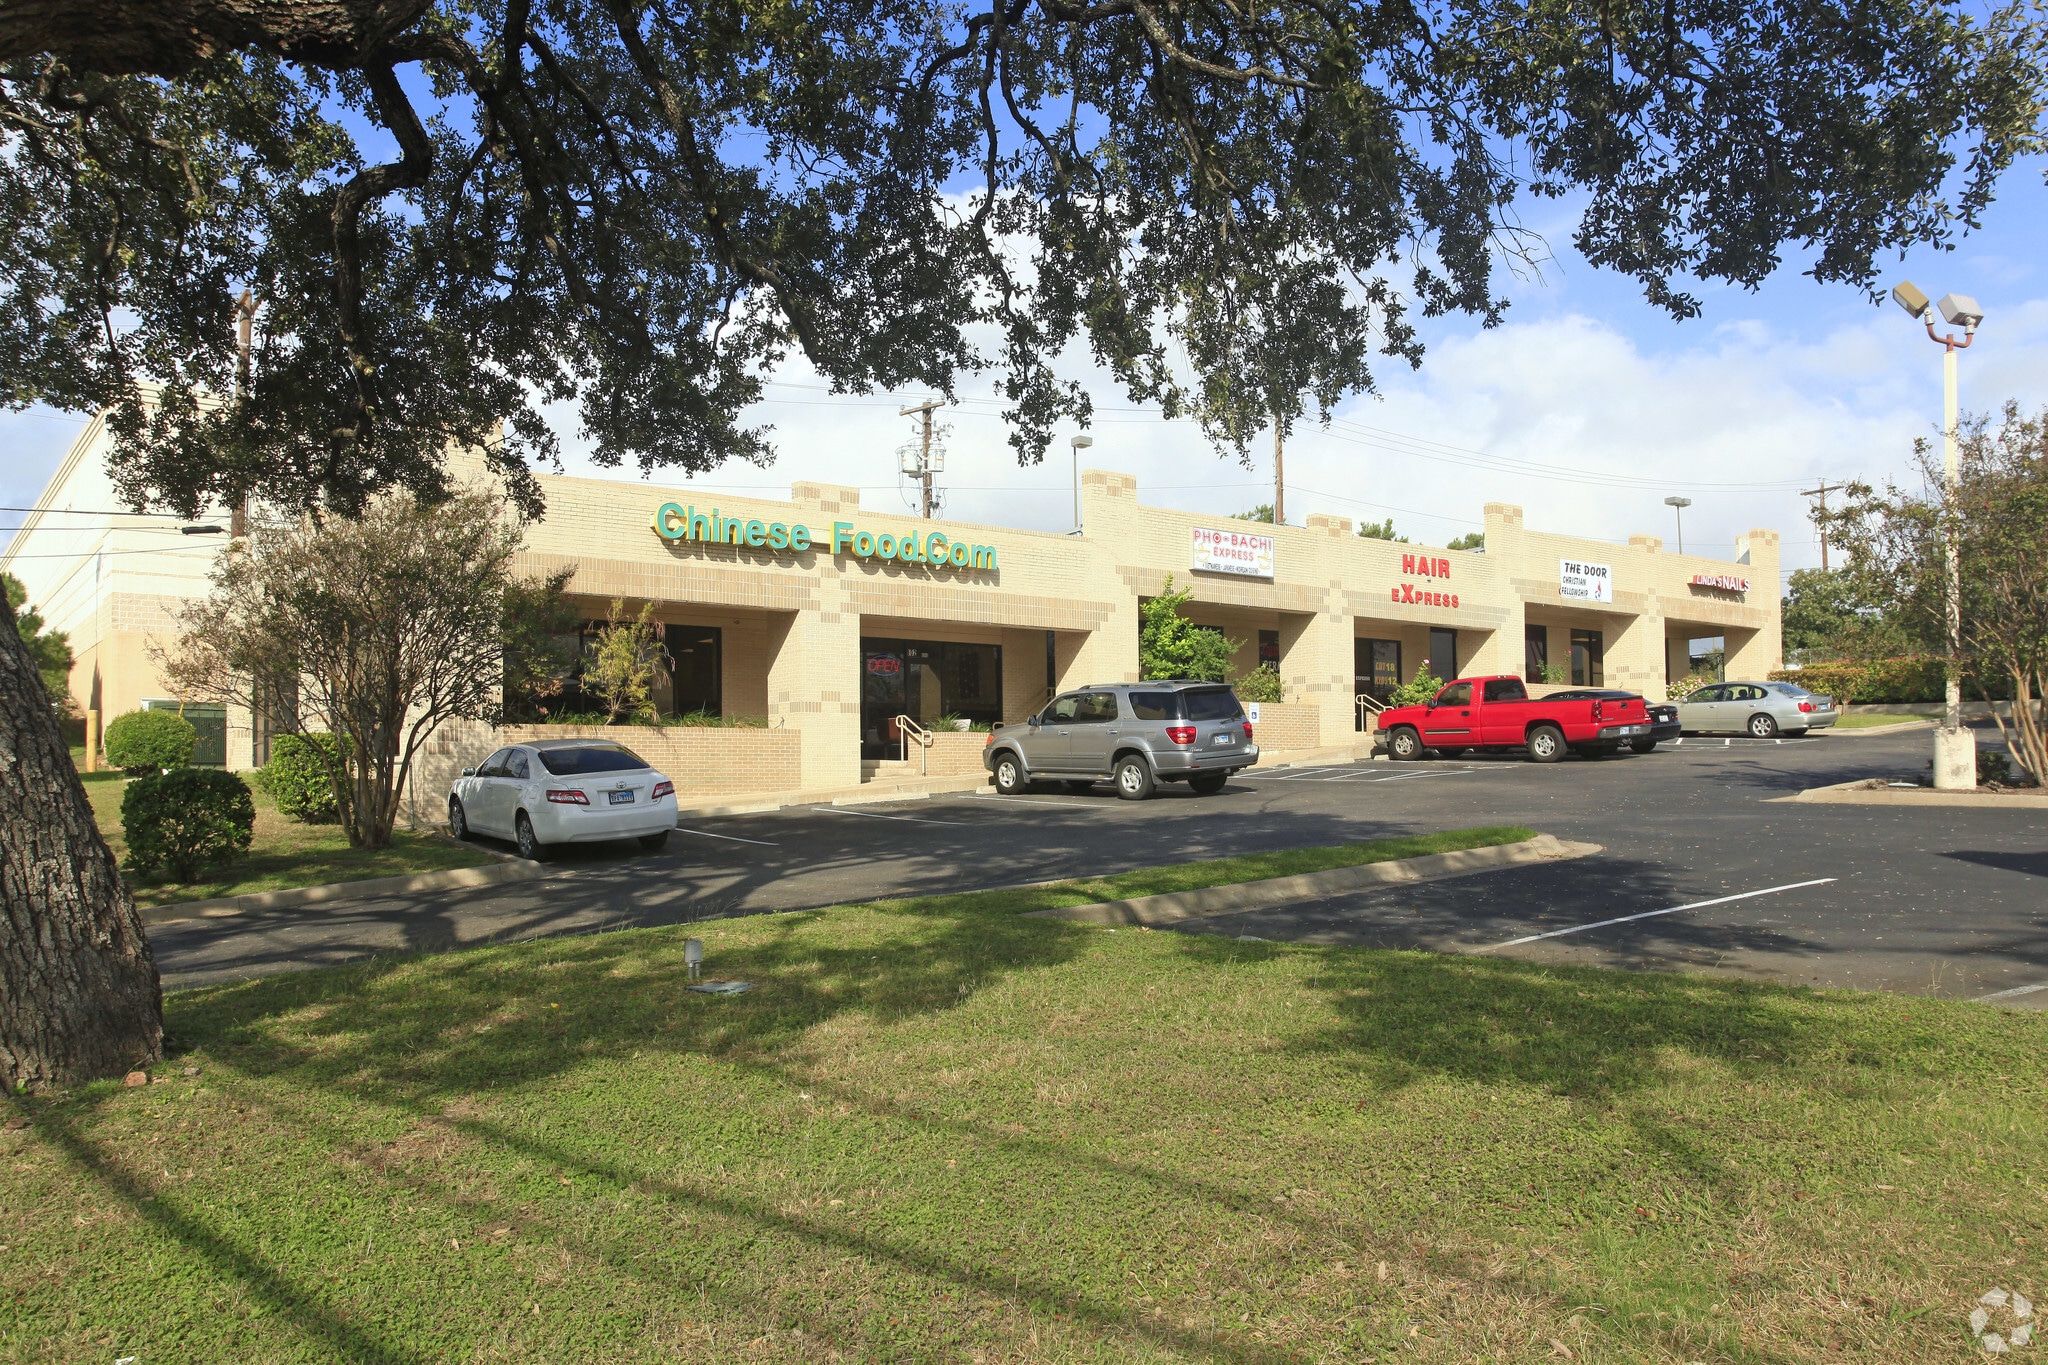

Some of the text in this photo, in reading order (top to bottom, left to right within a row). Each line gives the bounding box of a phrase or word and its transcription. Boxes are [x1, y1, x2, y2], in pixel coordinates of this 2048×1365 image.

[653, 502, 998, 570] Chinese Food.Com
[1194, 530, 1273, 551] PHO-BACHI
[1213, 546, 1255, 562] EXPRESS
[1402, 553, 1450, 579] HAIR
[1564, 562, 1608, 579] THE DOOR
[1562, 575, 1587, 587] CHRISTIAN
[1694, 574, 1751, 592] LINDA'S NAILS
[1391, 583, 1460, 609] EXPRESS
[1561, 586, 1589, 597] FELLOWSHIP
[867, 658, 901, 673] OPEN
[1386, 662, 1396, 672] 18
[1388, 676, 1398, 686] 12
